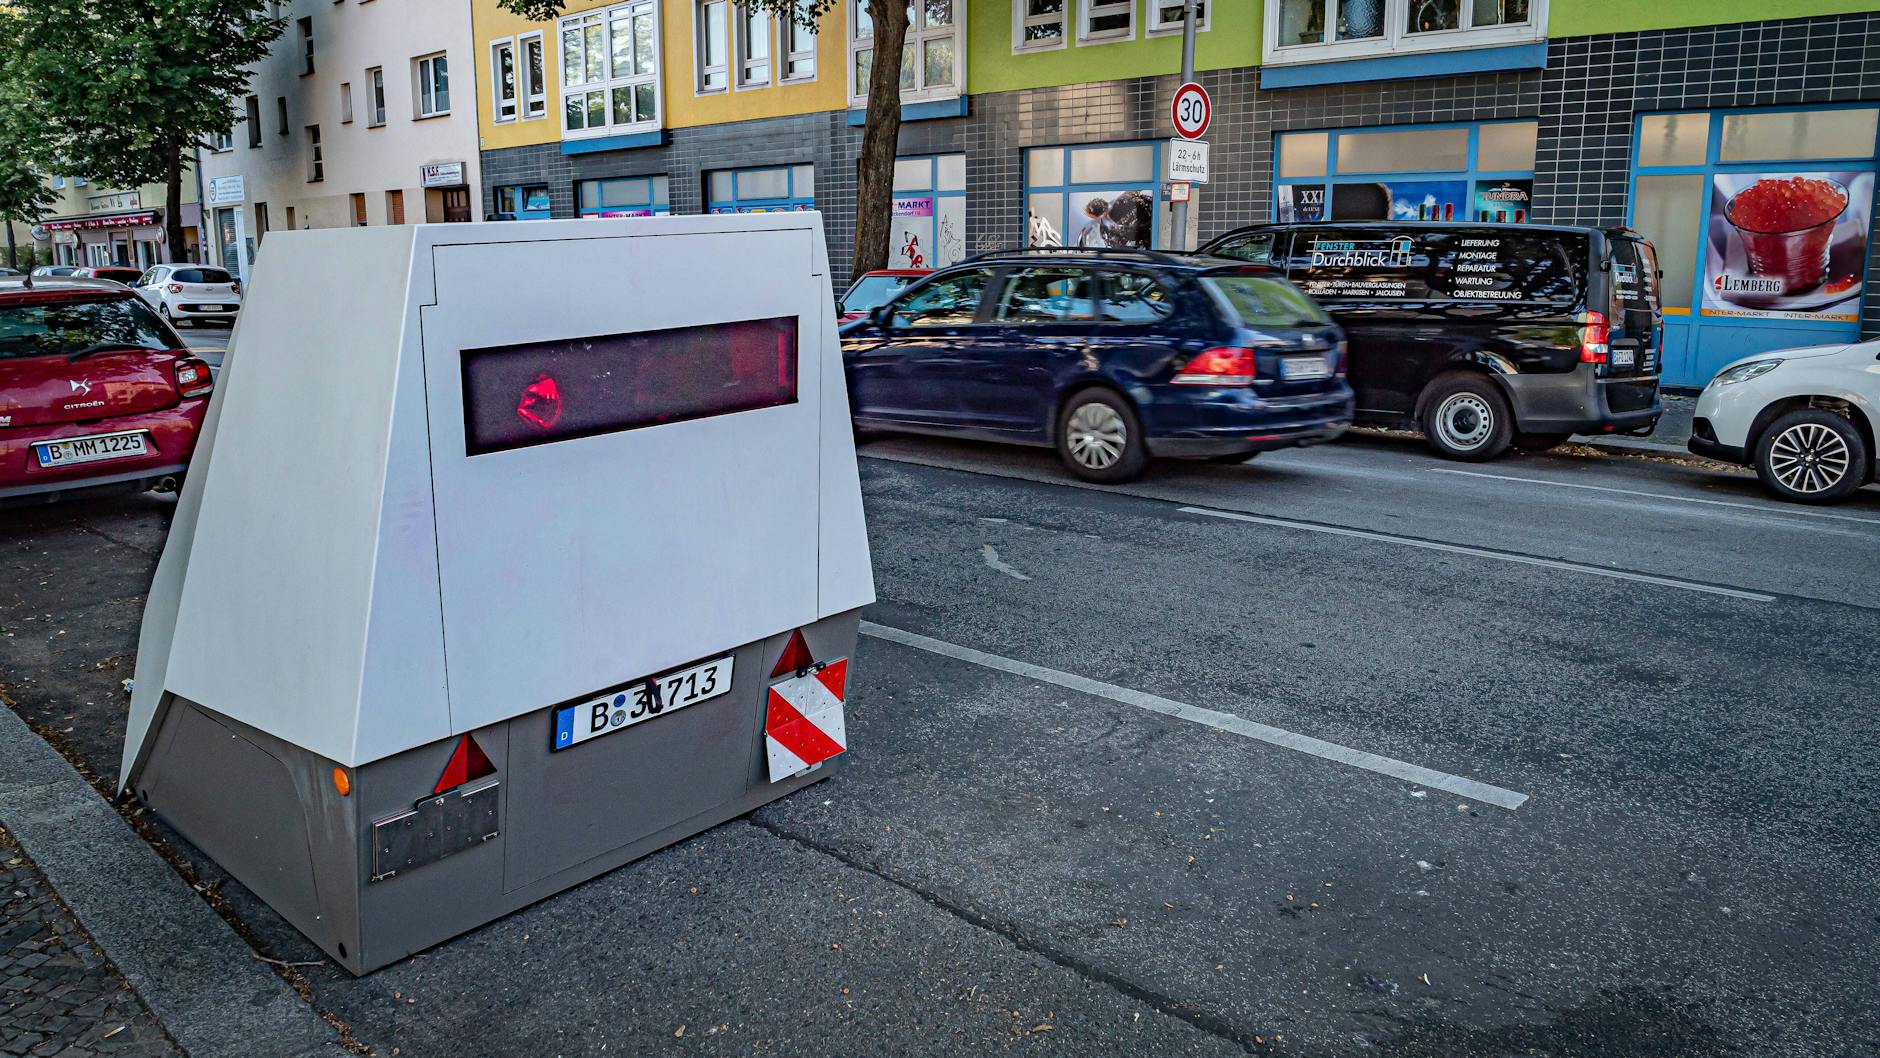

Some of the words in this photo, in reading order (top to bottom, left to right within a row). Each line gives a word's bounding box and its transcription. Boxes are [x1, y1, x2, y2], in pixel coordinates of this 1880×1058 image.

[1180, 97, 1203, 124] 30
[1172, 161, 1206, 174] Lärmschutz
[1301, 190, 1324, 204] XXI
[1483, 191, 1529, 201] TUNDRA
[892, 200, 930, 209] -MARKT
[1315, 242, 1356, 251] FENSTER
[1312, 251, 1387, 267] Durchblick
[1458, 252, 1498, 260] MONTAGE
[1456, 264, 1497, 273] REPARATUR
[1455, 277, 1494, 286] WARTUNG
[1724, 274, 1781, 292] LEMBERG
[1341, 289, 1370, 297] MARKISEN
[1453, 291, 1523, 300] OBJEKTBETREUUNG
[1708, 309, 1771, 318] INTER-MARKT
[1784, 312, 1850, 321] INTER-MARKT
[63, 400, 105, 410] CITROËN
[50, 445, 62, 460] B
[73, 441, 97, 457] MM
[100, 436, 141, 453] 1225
[590, 702, 609, 734] B
[561, 731, 569, 741] D
